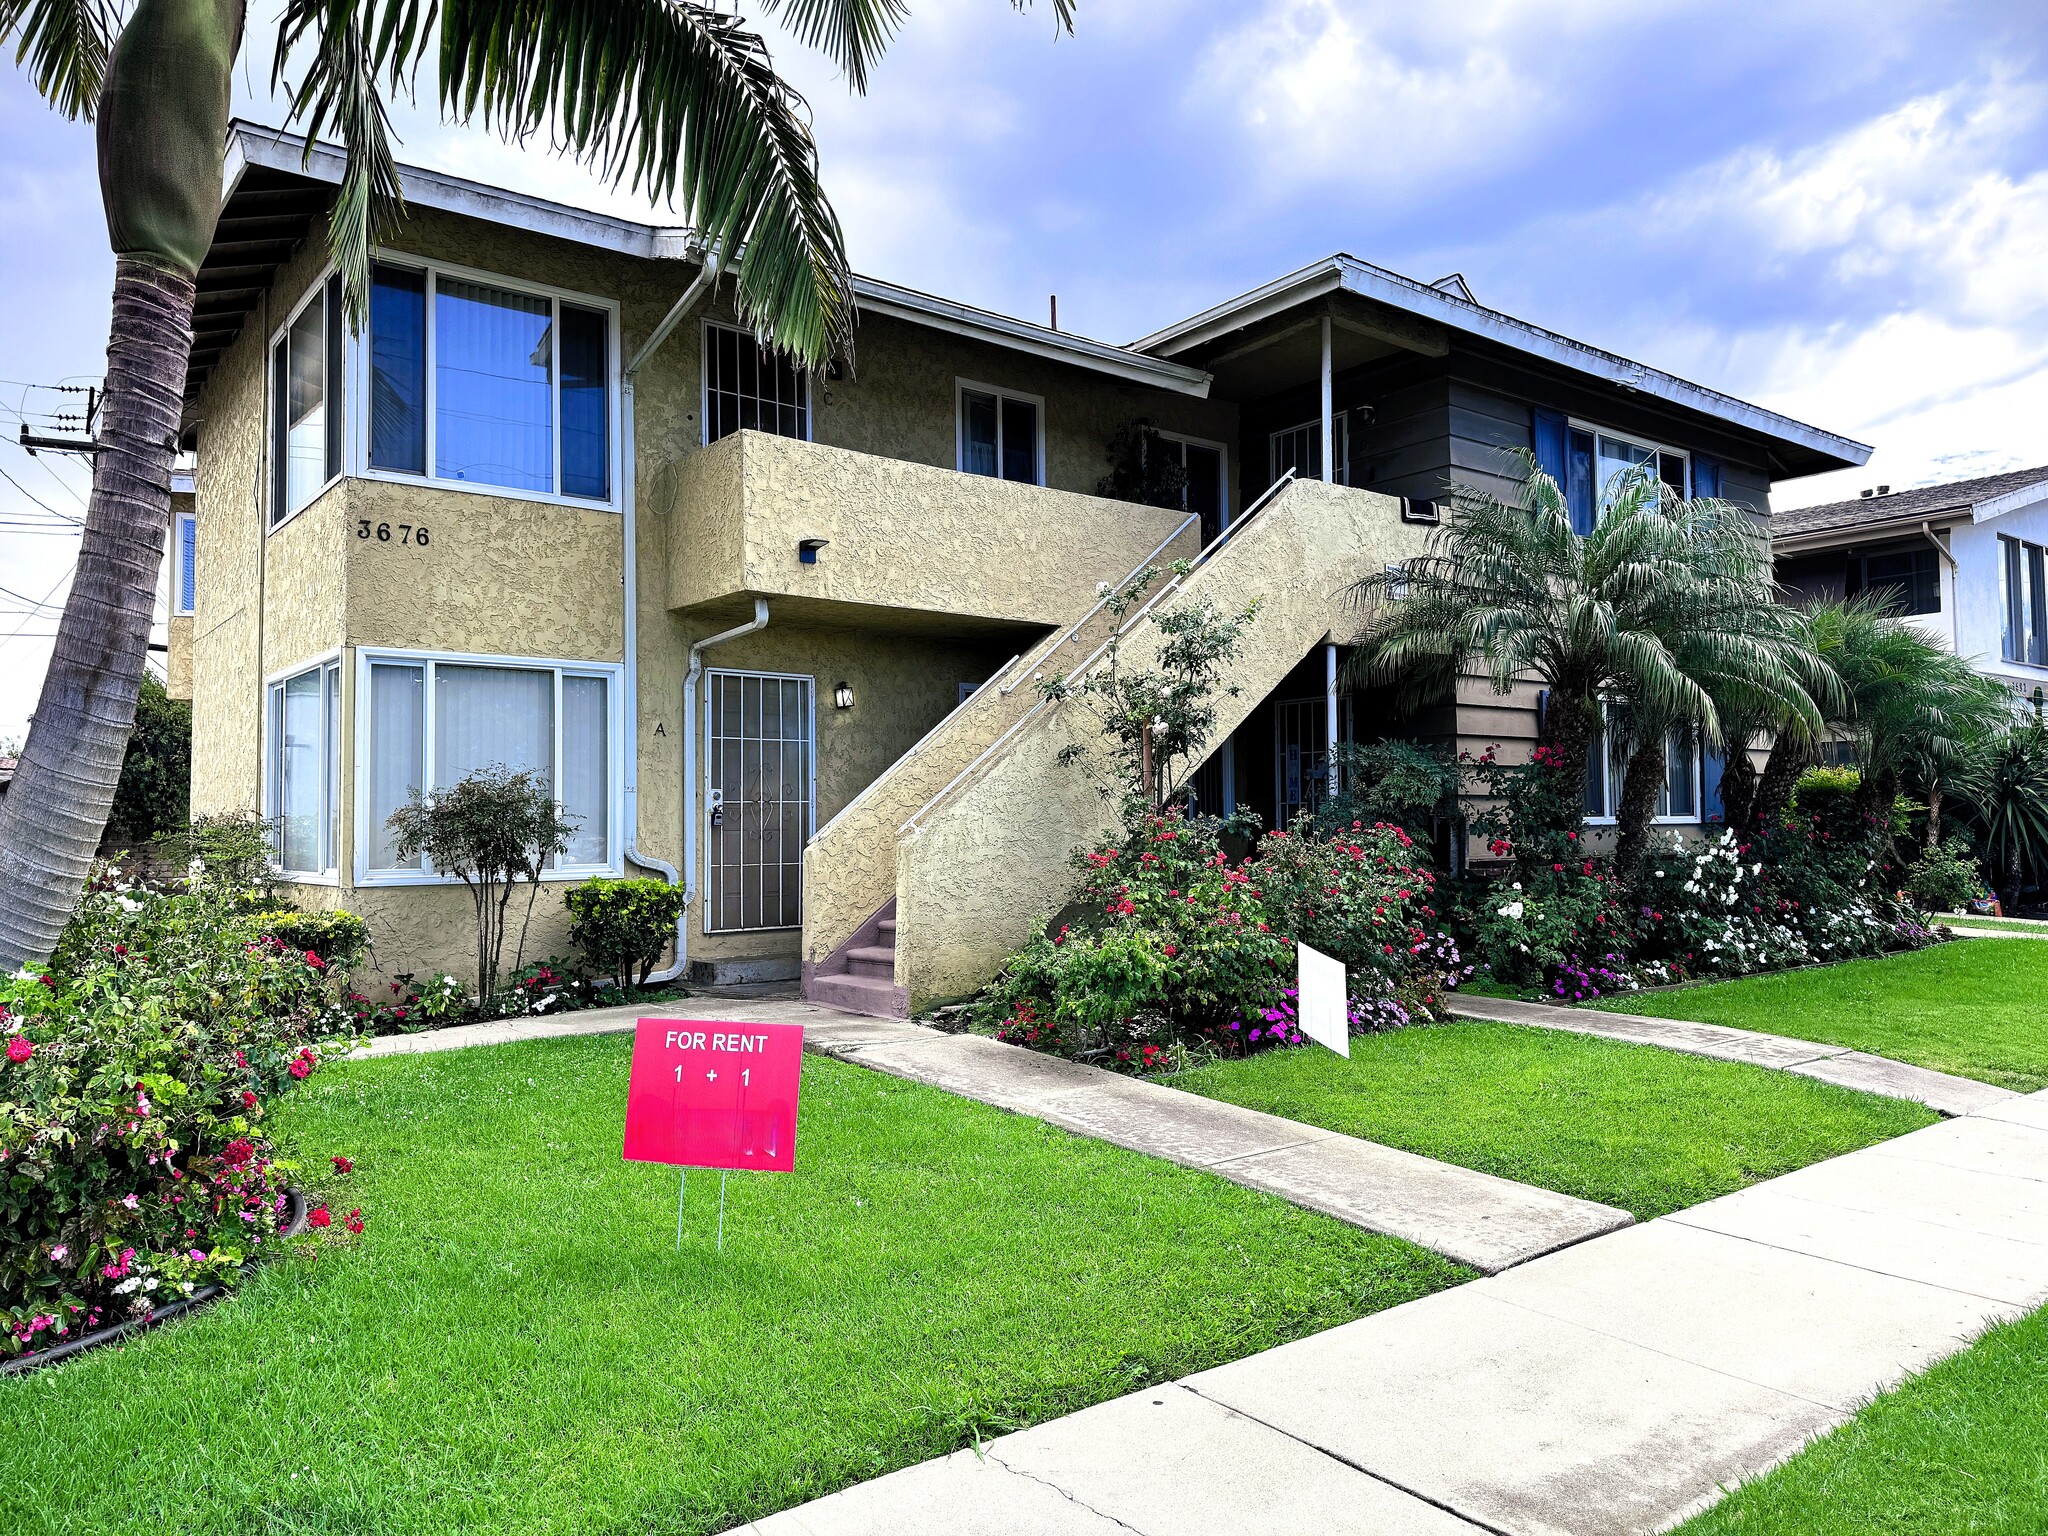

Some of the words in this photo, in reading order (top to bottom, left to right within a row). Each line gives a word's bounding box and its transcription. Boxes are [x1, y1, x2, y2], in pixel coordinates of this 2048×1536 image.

[823, 392, 833, 406] C
[357, 519, 430, 546] 3676
[653, 722, 667, 737] A
[665, 1030, 706, 1050] FOR
[712, 1033, 768, 1053] RENT
[674, 1064, 683, 1083] 1
[706, 1069, 718, 1082] +
[741, 1068, 750, 1087] 1
